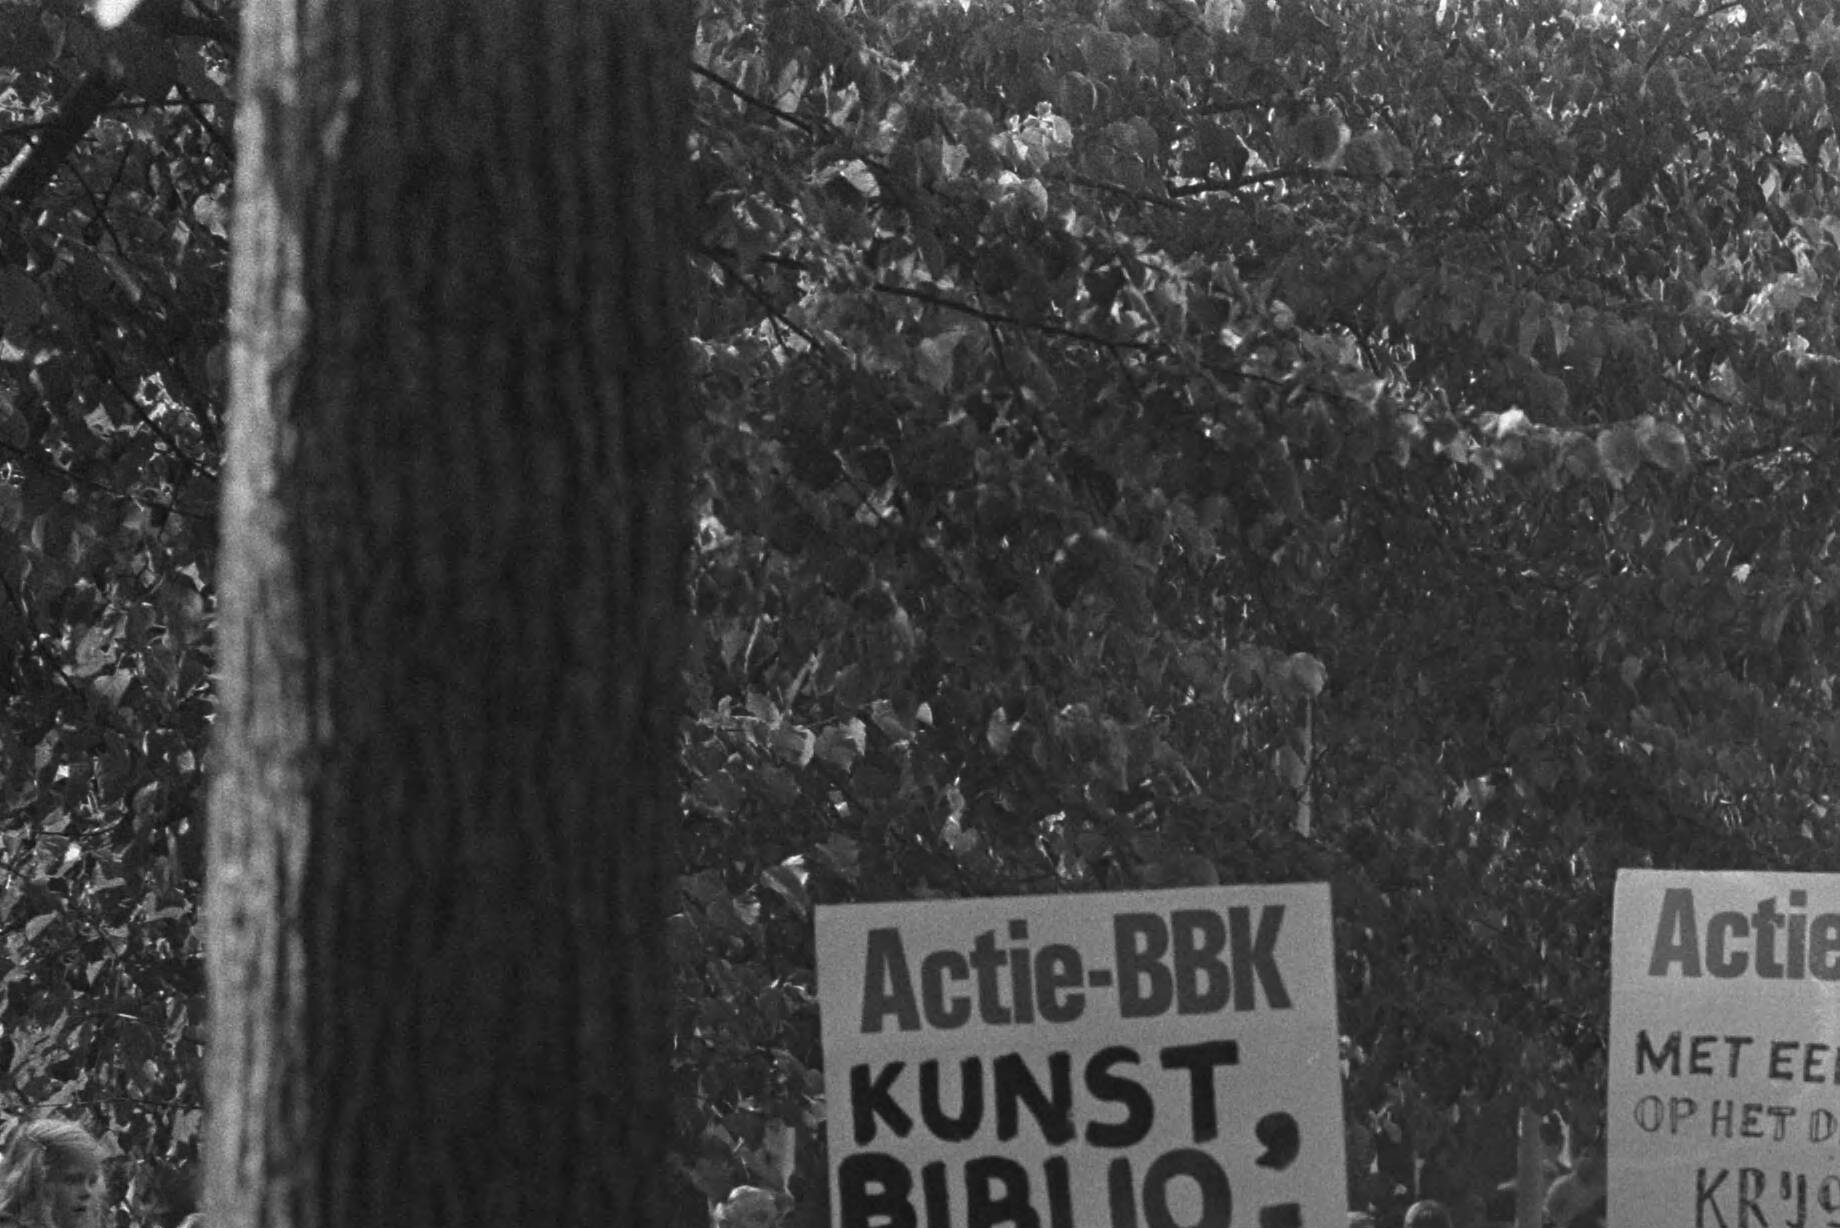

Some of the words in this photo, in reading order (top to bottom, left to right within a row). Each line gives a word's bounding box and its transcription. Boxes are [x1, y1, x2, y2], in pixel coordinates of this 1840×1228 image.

[860, 904, 1293, 1034] Actie-BBK
[1635, 1029, 1754, 1080] MET
[849, 1040, 1301, 1171] KUNST,
[1633, 1094, 1697, 1135] OP
[1710, 1099, 1796, 1141] HET
